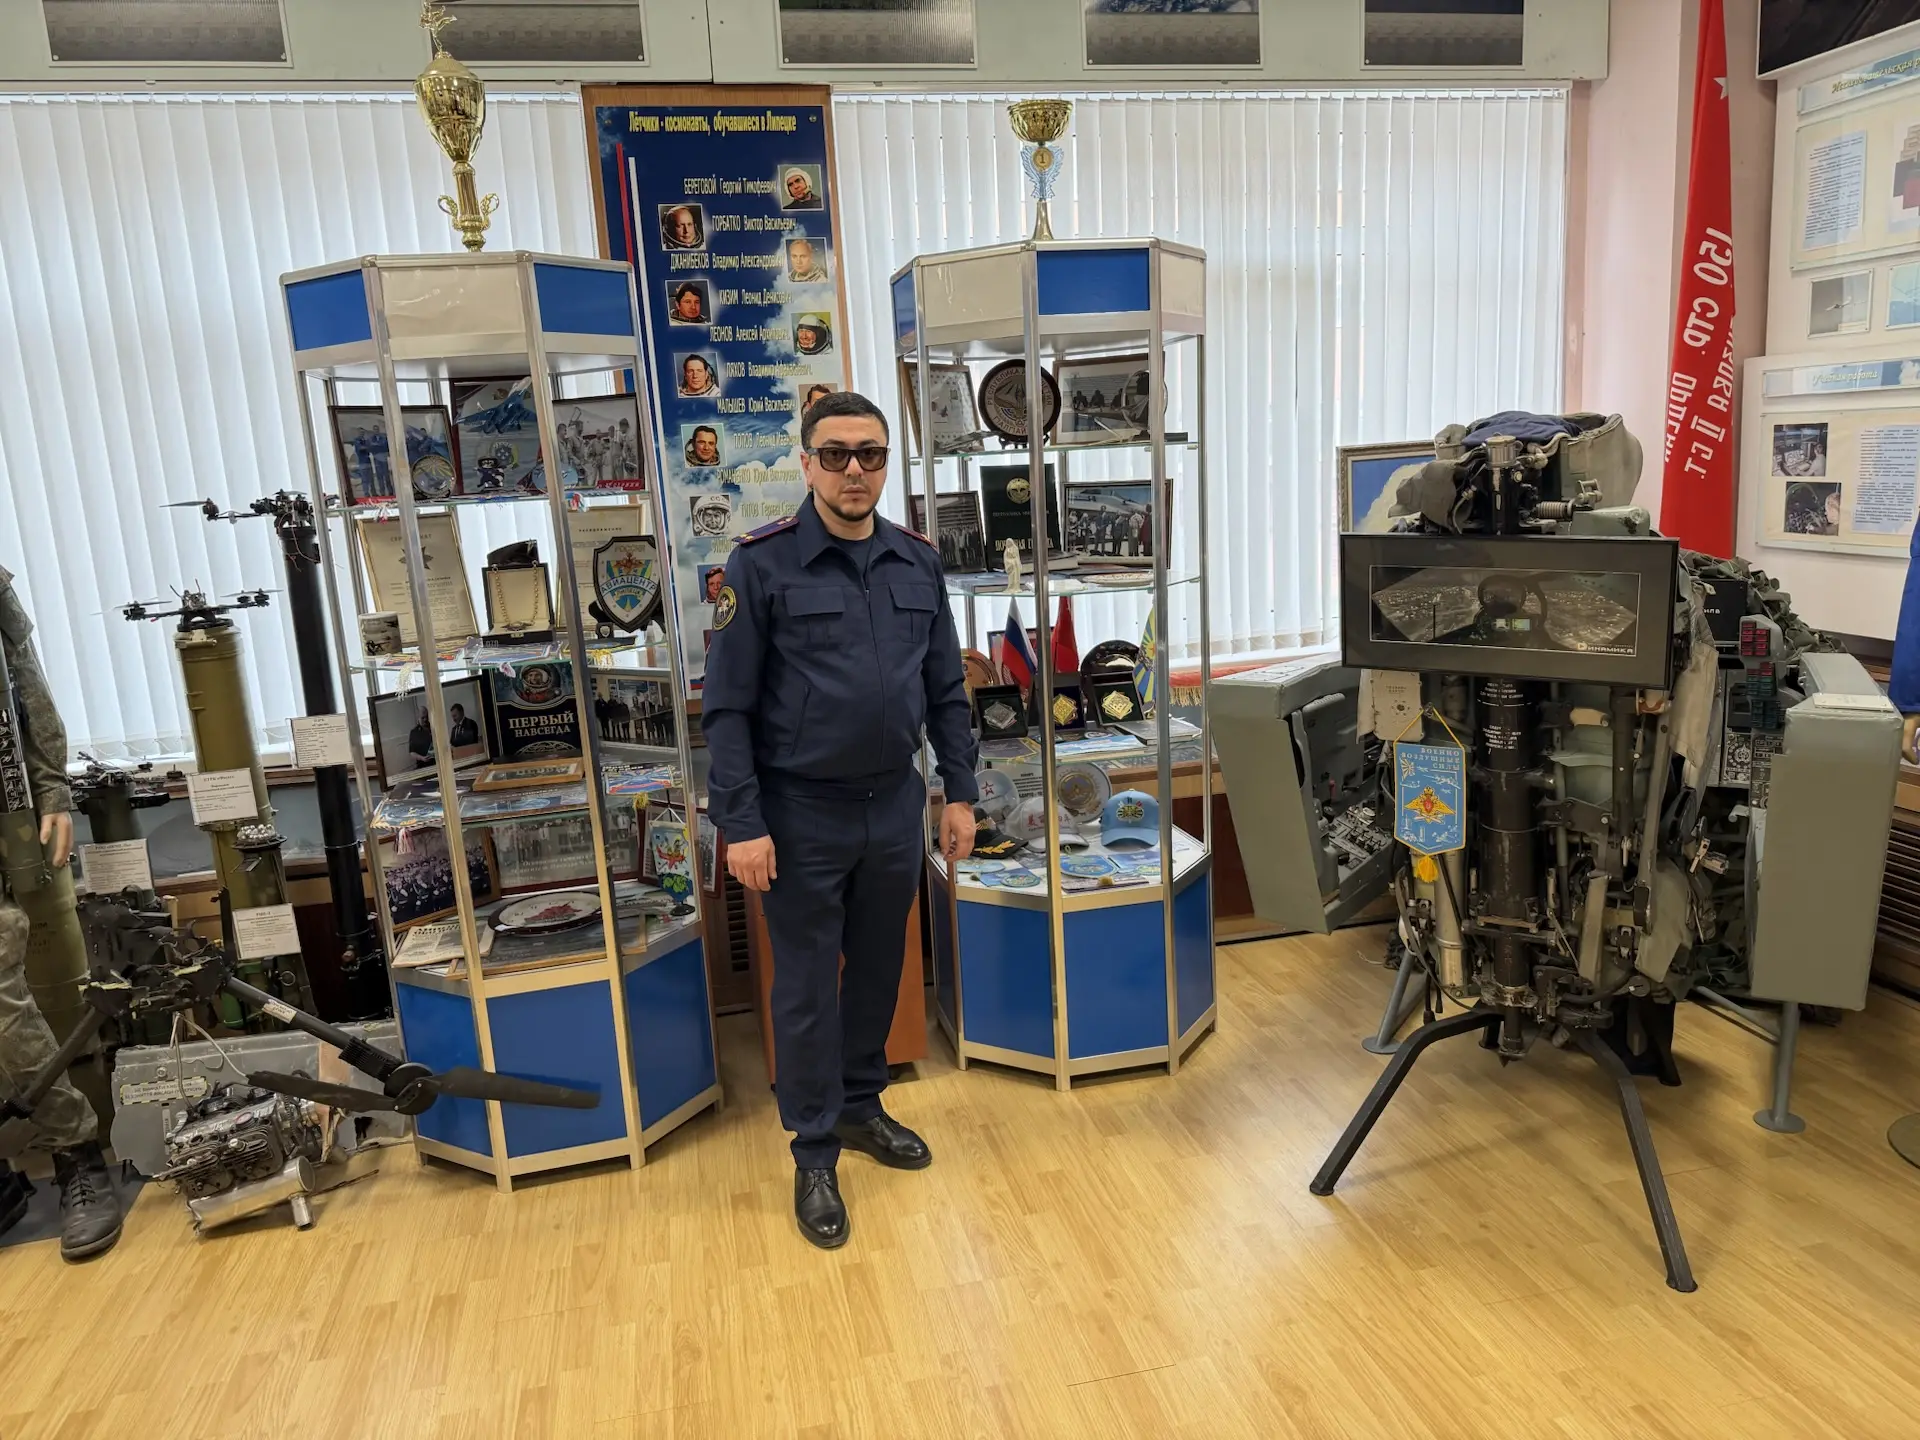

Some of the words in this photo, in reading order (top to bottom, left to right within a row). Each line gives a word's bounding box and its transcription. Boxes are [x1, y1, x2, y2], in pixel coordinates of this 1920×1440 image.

[629, 111, 659, 132] Лётчики
[665, 114, 711, 136] космонавты,
[714, 111, 760, 136] обучавшиеся
[761, 117, 766, 131] в
[766, 111, 797, 135] Липецке
[684, 174, 717, 195] БЕРЕГОВОЙ
[720, 176, 742, 198] Георгий
[742, 177, 777, 198] Тимофеевич
[712, 214, 741, 232] ГОРБАТКО
[743, 215, 763, 234] Виктор
[670, 253, 710, 273] ДЖАНИБЕКОВ
[712, 253, 740, 272] Владимир
[719, 289, 738, 305] КИЗИМ
[742, 289, 762, 307] Леонид
[709, 325, 733, 342] ЛЕОНОВ
[735, 324, 759, 342] Алексей
[726, 361, 746, 378] ЛЯХОВ
[748, 361, 775, 380] Владимир
[717, 397, 746, 414] МАЛЫШЕВ
[748, 396, 764, 416] Юрий
[733, 433, 753, 449] ПОПОВ
[717, 468, 751, 484] РОМАНЕНКО
[390, 533, 432, 542] СЕРКАТ
[601, 576, 657, 595] АВИАЦЕНТР
[508, 710, 576, 729] ПЕРВЫЙ
[514, 724, 572, 738] НАВСЕГДА
[1401, 752, 1460, 763] ВОЗДУШНЫЕ
[1420, 747, 1460, 757] ВОЕННО
[1432, 763, 1460, 771] СИЛЫ
